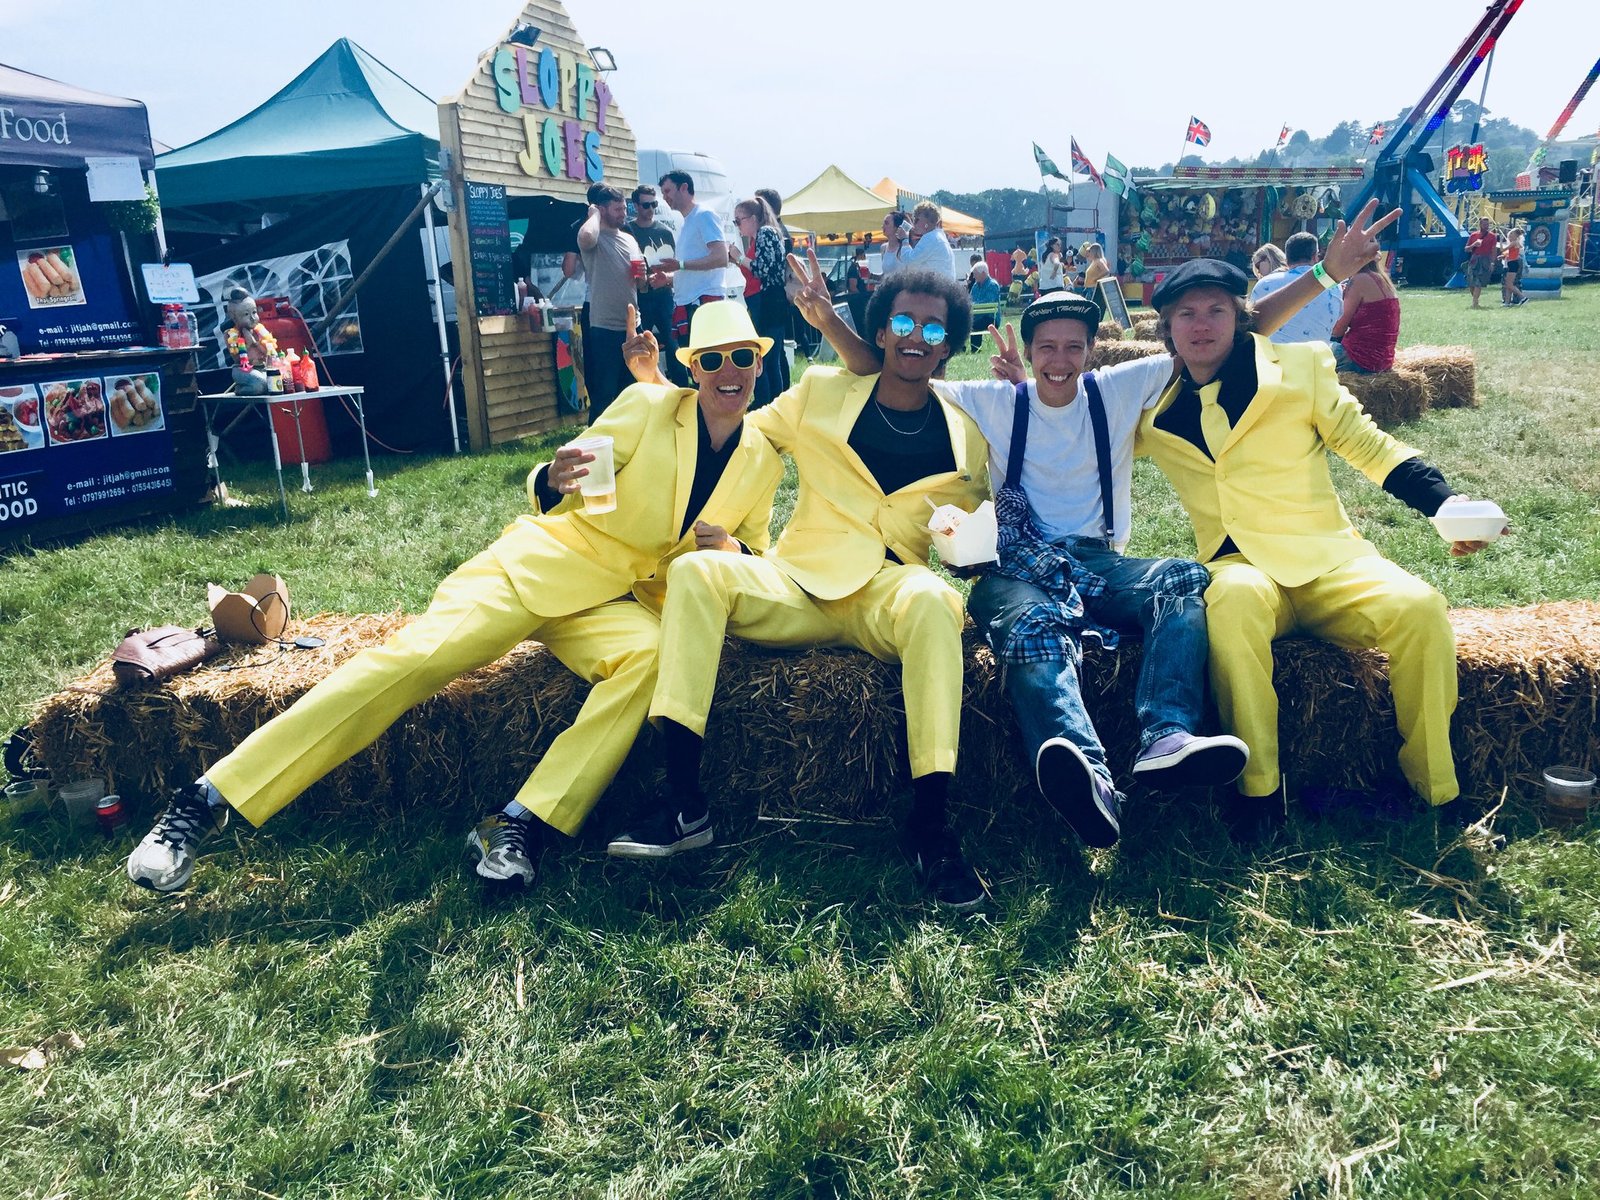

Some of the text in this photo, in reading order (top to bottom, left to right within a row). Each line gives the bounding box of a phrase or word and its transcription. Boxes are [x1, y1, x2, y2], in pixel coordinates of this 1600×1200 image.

[492, 47, 613, 135] SLOPPY
[0, 106, 72, 145] Food
[516, 113, 604, 183] JOES
[39, 325, 64, 335] e-mail
[0, 481, 28, 499] TIC
[67, 478, 95, 491] e-mail
[64, 497, 76, 507] Tel
